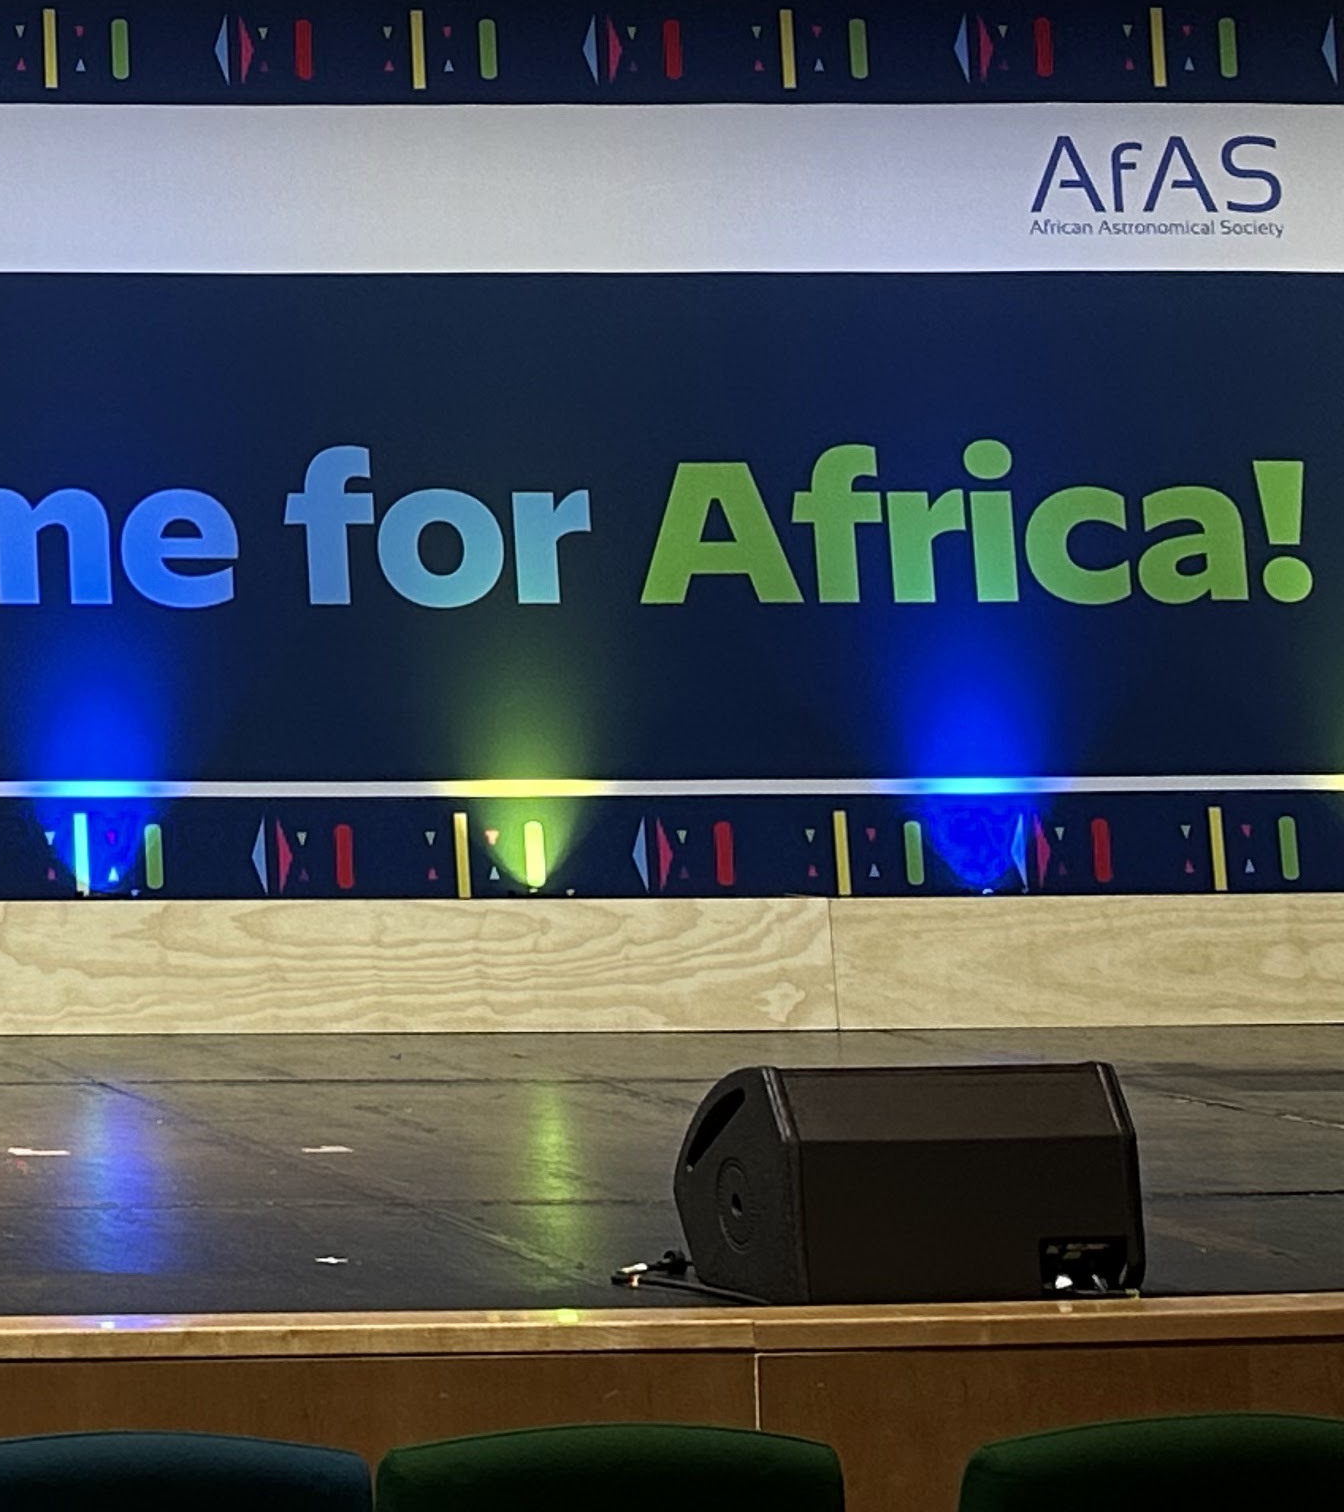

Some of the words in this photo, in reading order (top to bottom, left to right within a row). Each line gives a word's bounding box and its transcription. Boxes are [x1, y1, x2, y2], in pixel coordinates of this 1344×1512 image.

[1030, 135, 1283, 214] AfAS
[1029, 218, 1093, 236] African
[1098, 219, 1215, 236] Astronomical
[1220, 219, 1285, 239] Society
[284, 444, 592, 609] for
[640, 438, 1314, 606] Africa!
